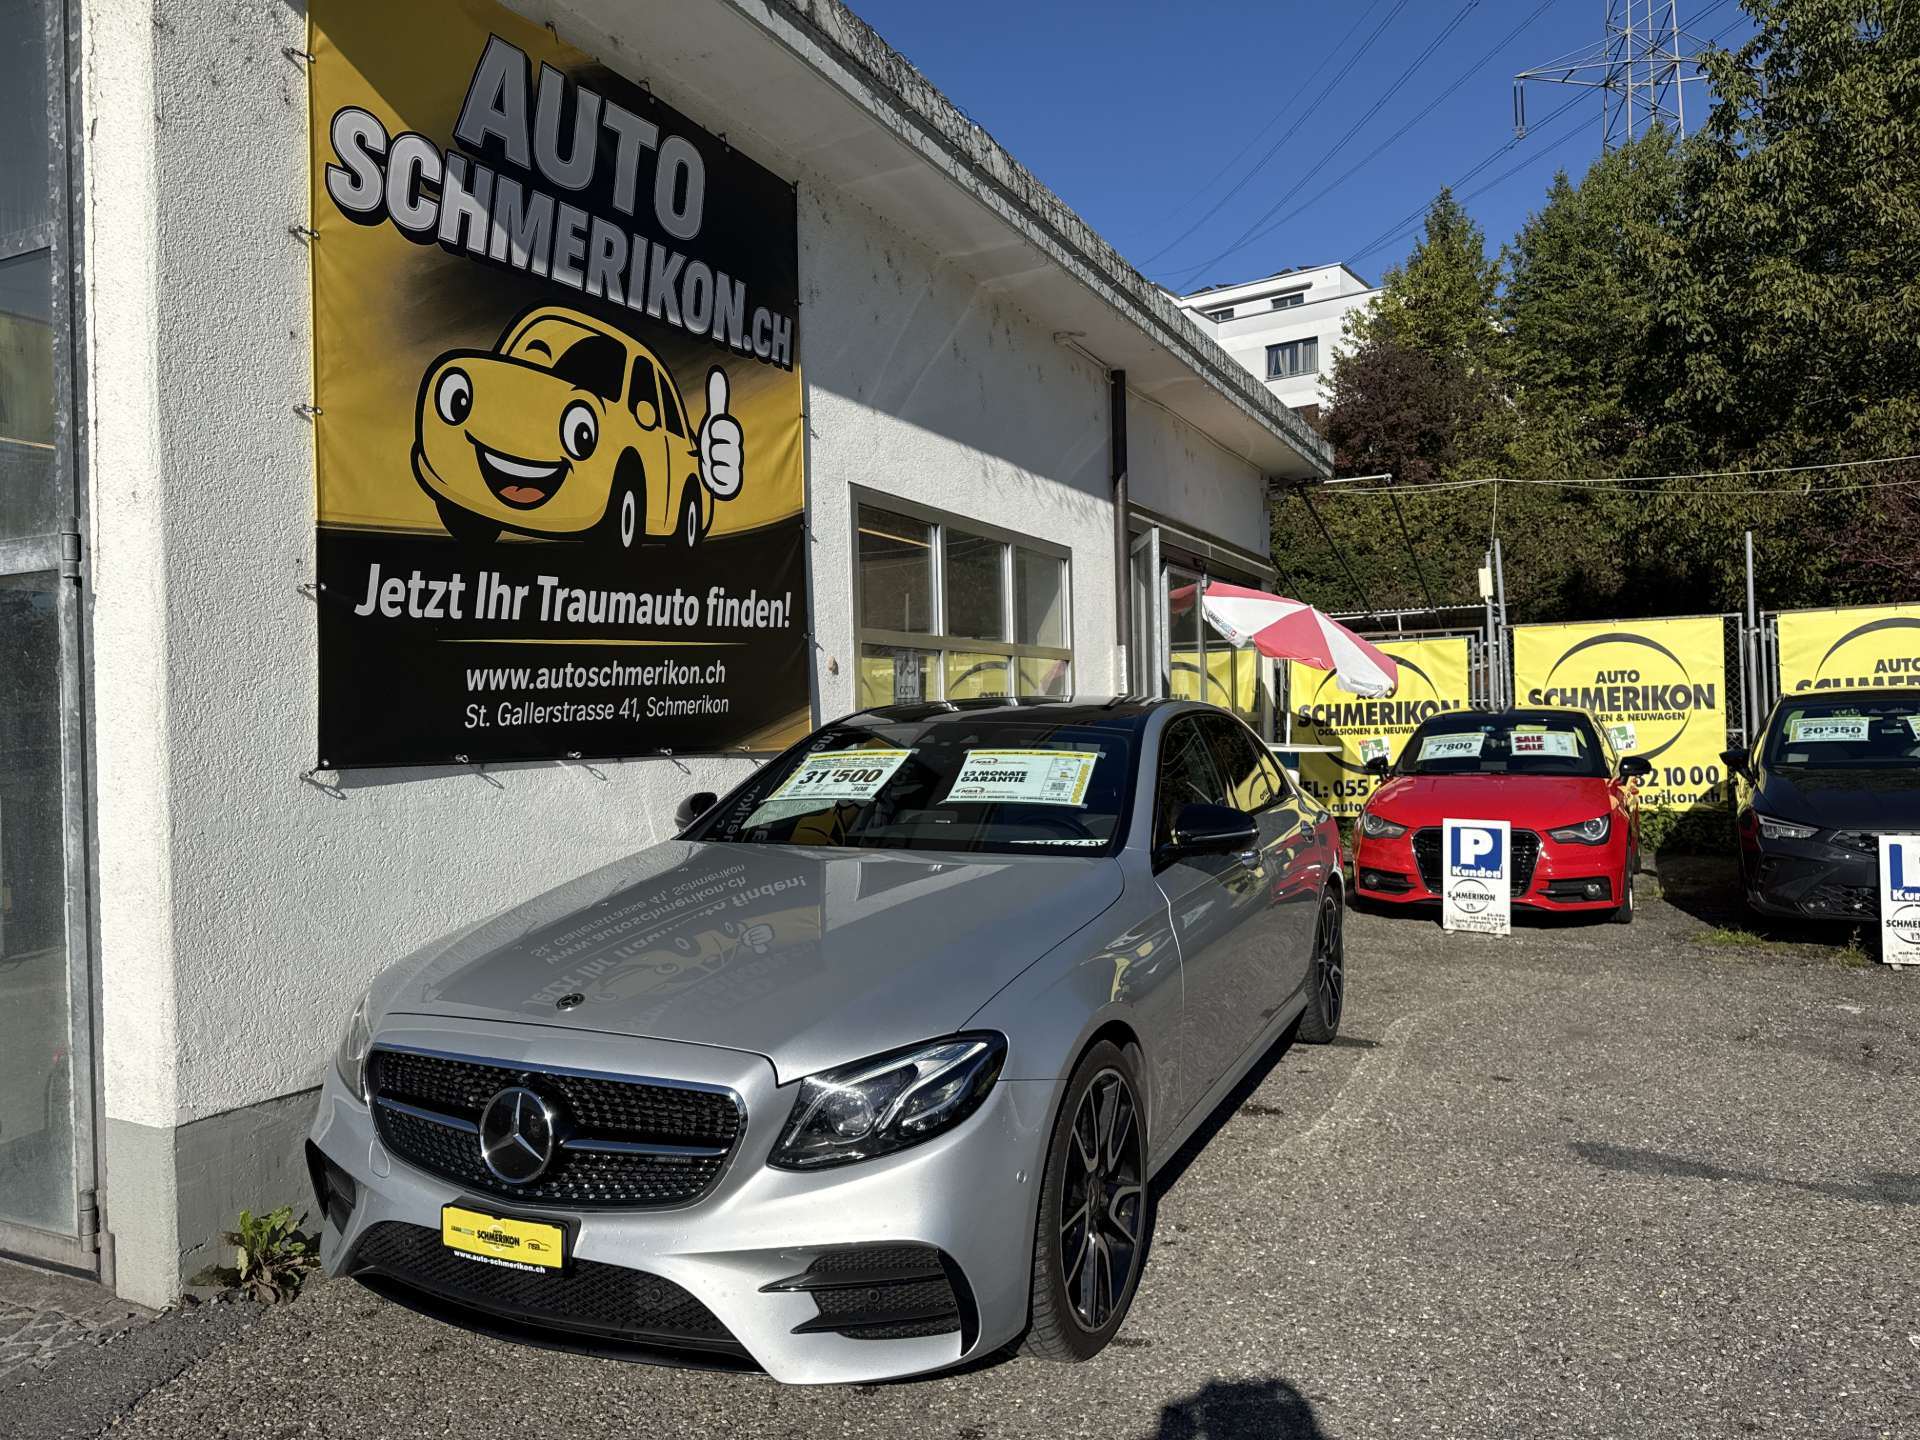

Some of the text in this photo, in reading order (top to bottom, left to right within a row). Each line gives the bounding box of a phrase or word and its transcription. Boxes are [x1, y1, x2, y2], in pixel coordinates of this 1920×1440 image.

[454, 33, 706, 240] AUTO
[326, 106, 793, 369] SCHMERIKON.CH
[354, 563, 792, 629] Jetzt Ihr Traumauto finden!
[466, 660, 726, 691] www.autoschmerikon.ch
[1595, 669, 1640, 684] AUTO
[1528, 683, 1715, 712] SCHMERIKON
[464, 695, 729, 728] St. Gallerstrasse 41, Schmerikon
[1616, 713, 1624, 722] &
[1627, 712, 1685, 721] NEUWAGEN
[1373, 727, 1380, 735] &
[1383, 726, 1416, 735] NEUWA
[1514, 735, 1544, 743] SALE
[1803, 726, 1861, 735] 20'350
[1434, 742, 1473, 751] 7'800
[1514, 743, 1544, 751] SALE
[798, 768, 884, 785] 31'500
[1333, 779, 1369, 798] 055
[1451, 864, 1503, 880] Kunden
[476, 1229, 520, 1246] SCHMERIKON
[453, 1249, 546, 1274] www.auto-schmerikon.ch
